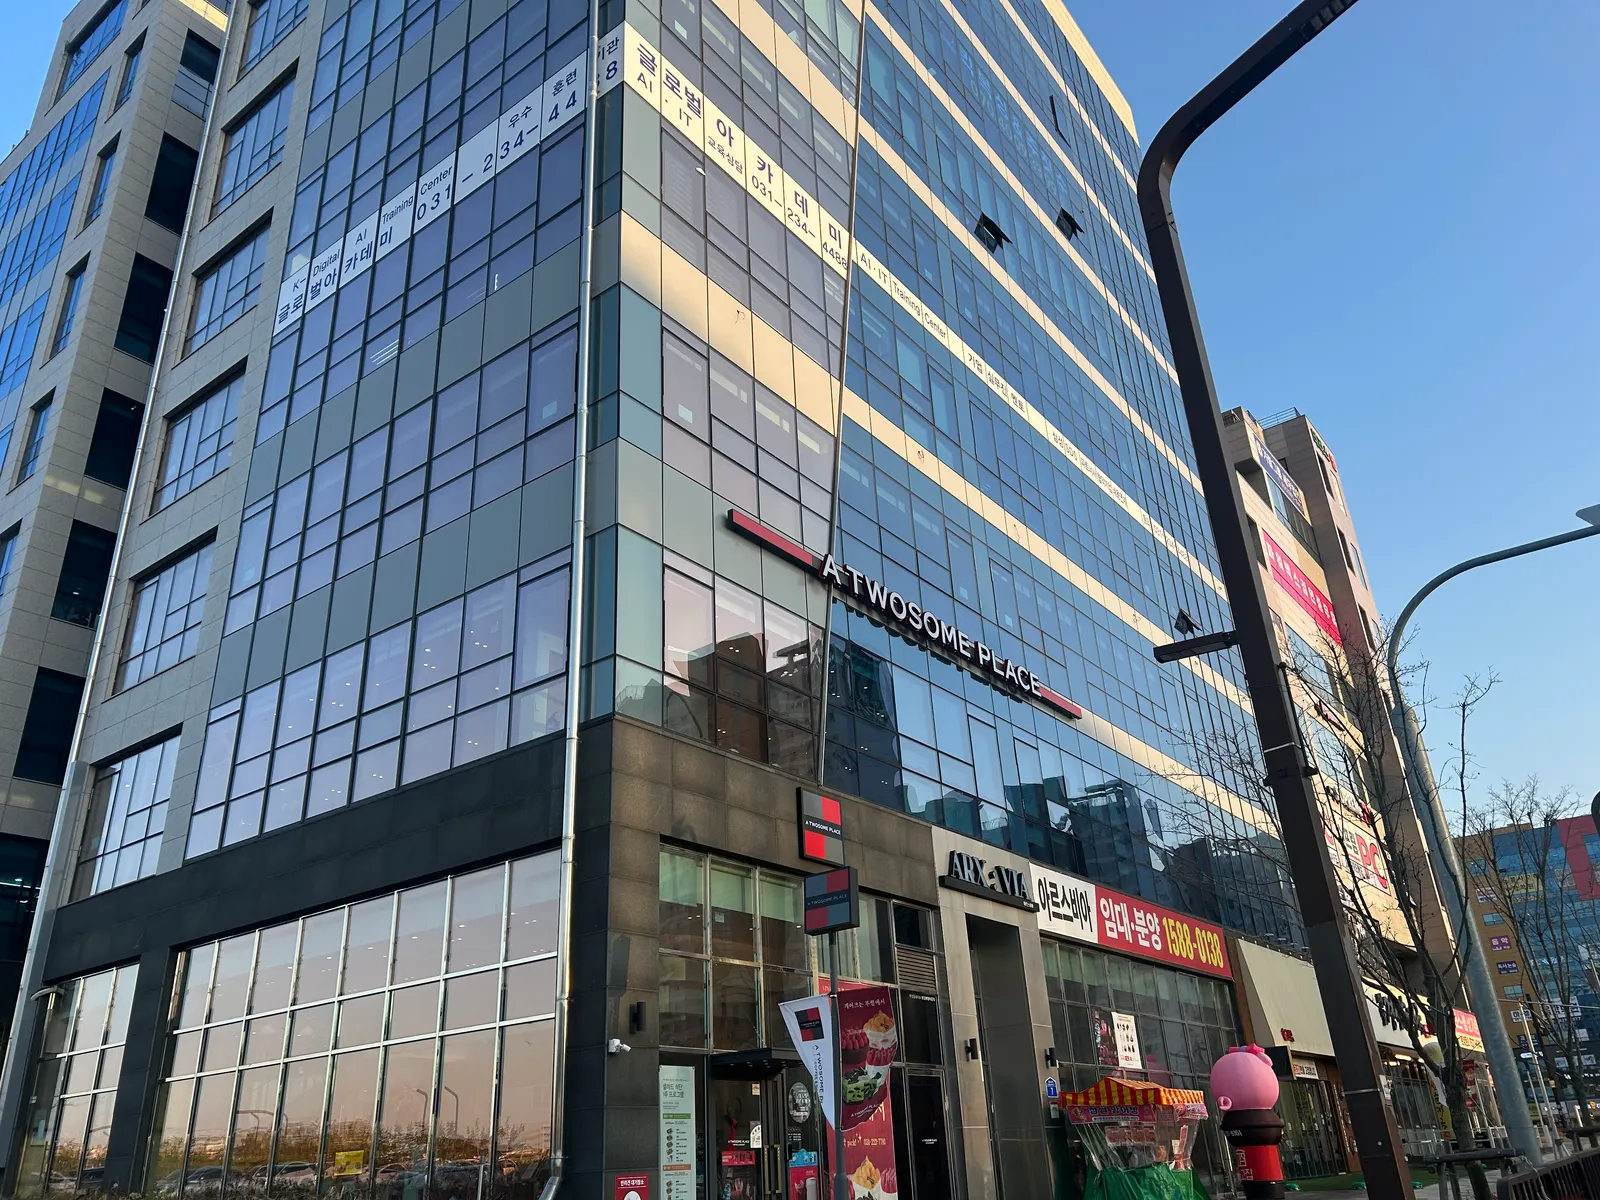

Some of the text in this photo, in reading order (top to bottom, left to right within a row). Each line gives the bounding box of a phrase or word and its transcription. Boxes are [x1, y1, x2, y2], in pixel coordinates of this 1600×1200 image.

[354, 229, 367, 246] AI
[382, 194, 414, 225] Training
[420, 165, 453, 197] Center
[508, 105, 533, 128] 우수
[551, 67, 577, 97] 훈련
[892, 281, 921, 317] Training
[924, 312, 947, 340] Center
[821, 553, 1043, 699] A TWOSOME PLACE
[809, 821, 829, 832] TWOSOME
[829, 825, 841, 836] PLACE
[949, 850, 988, 889] ARX
[995, 865, 1031, 901] VIA
[1037, 876, 1093, 933] 아르스비아
[1162, 916, 1224, 969] 1588-0138
